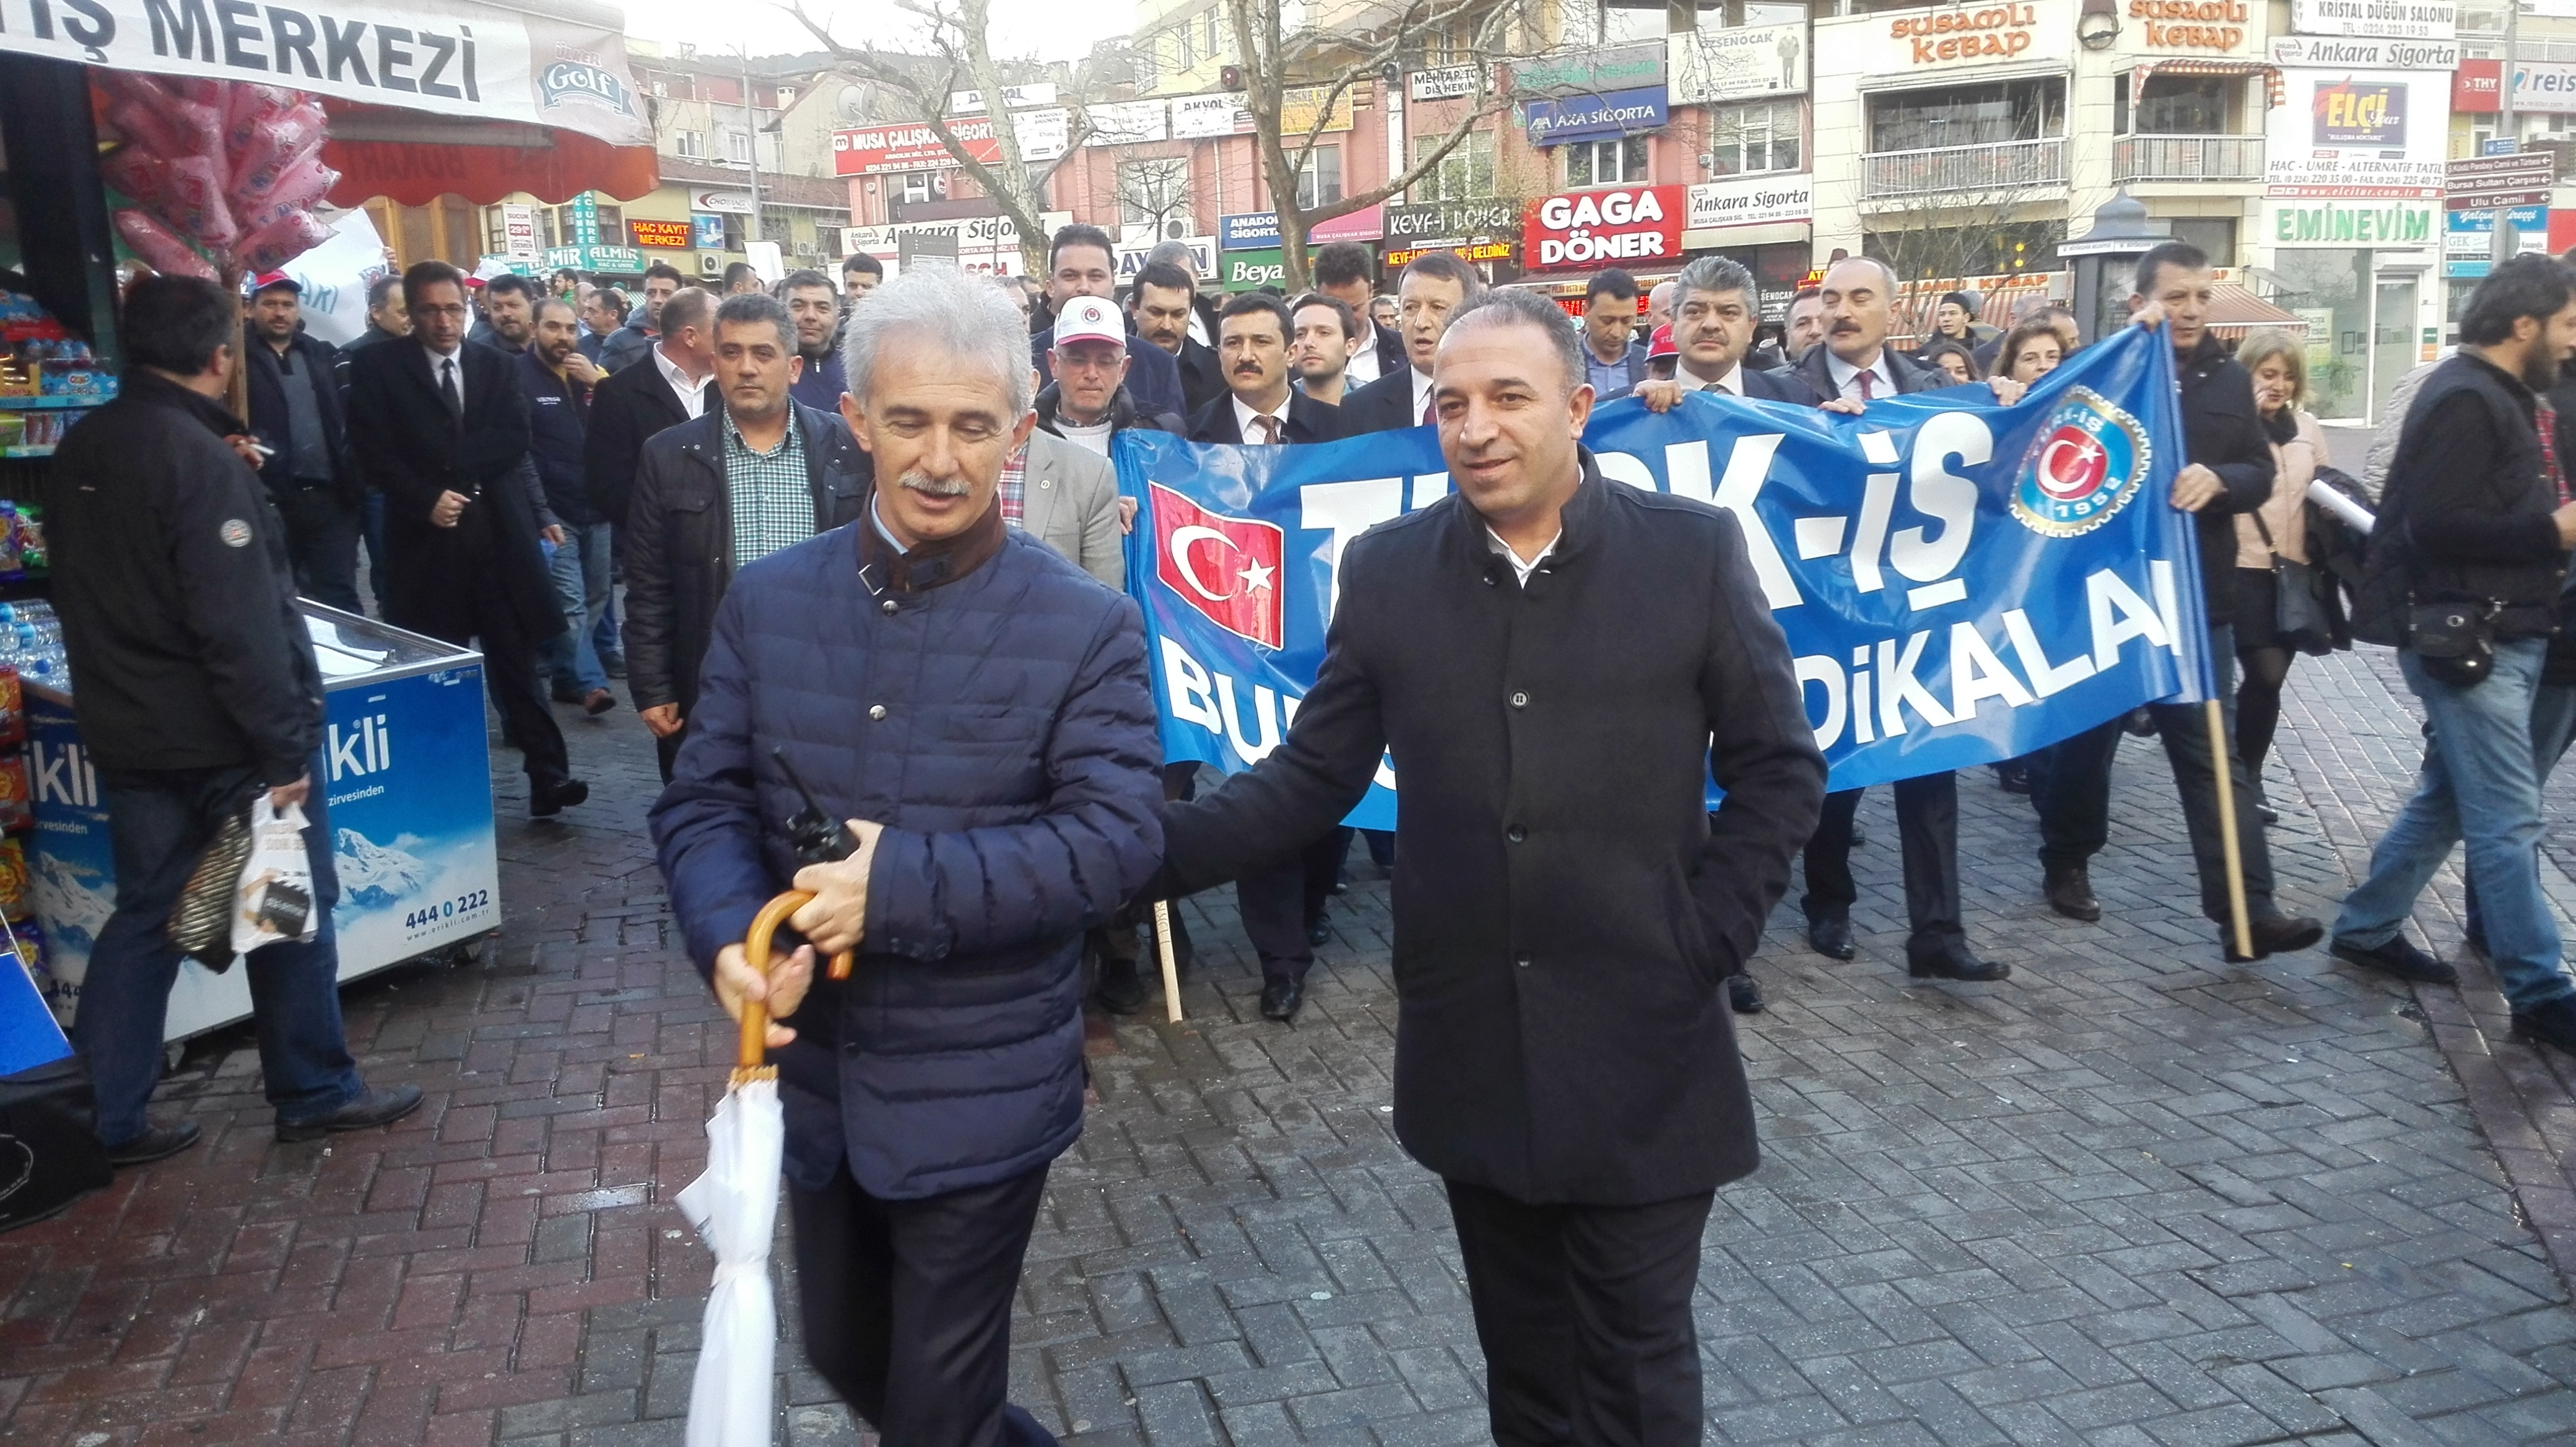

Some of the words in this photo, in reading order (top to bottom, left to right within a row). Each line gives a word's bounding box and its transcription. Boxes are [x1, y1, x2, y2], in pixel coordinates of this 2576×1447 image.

[2411, 6, 2453, 22] SALONU
[2387, 25, 2402, 35] 223
[2407, 26, 2416, 35] 19
[2418, 26, 2428, 35] 53
[0, 0, 116, 63] IŞ
[144, 0, 481, 103] MERKEZİ
[2308, 42, 2378, 63] Ankara
[2387, 43, 2456, 66] Sigorta
[547, 64, 613, 98] Golf
[2473, 77, 2498, 89] THY
[1591, 105, 1656, 124] SİGORTA
[2326, 88, 2389, 134] ELÇİ
[853, 132, 887, 151] MUSA
[889, 127, 941, 152] ÇALIŞKA
[950, 121, 998, 142] SİGORT
[2270, 160, 2295, 172] HAC
[2306, 161, 2338, 172] UMRE
[2311, 174, 2326, 183] 220
[2329, 174, 2339, 183] 35
[2432, 177, 2443, 186] 73
[2447, 181, 2474, 190] Bursa
[2476, 178, 2505, 188] Sultan
[1540, 190, 1664, 230] GAGA
[1694, 196, 1749, 212] Ankara
[1752, 189, 1809, 209] Sigorta
[2470, 197, 2489, 208] Ulu
[2492, 195, 2525, 206] Camii
[633, 222, 656, 234] HAC
[659, 223, 689, 235] KAYIT
[857, 238, 879, 247] Sigorta
[1541, 230, 1664, 265] DÖNER
[2448, 236, 2470, 247] GEK
[1231, 261, 1286, 286] Beya
[328, 785, 385, 807] zirvesinden
[34, 819, 88, 834] rvesinden
[406, 905, 439, 929] 444
[443, 901, 453, 918] 0
[458, 890, 489, 914] 222
[406, 909, 490, 942] www.erikli.com.tr
